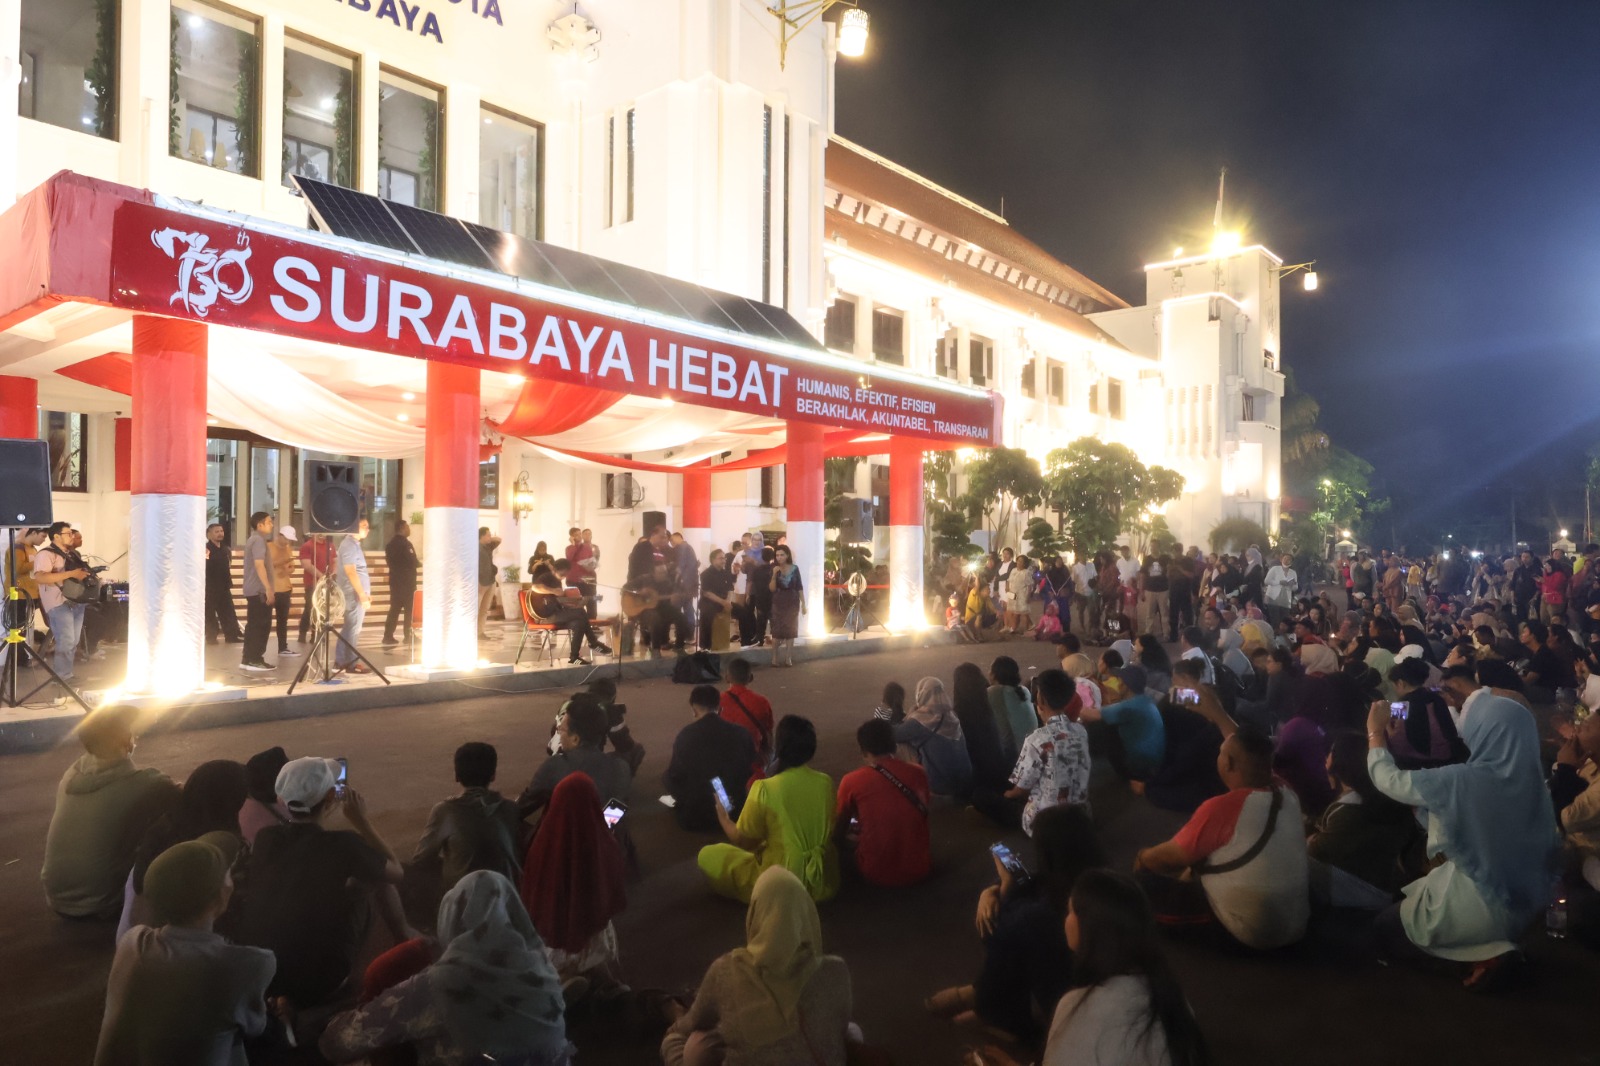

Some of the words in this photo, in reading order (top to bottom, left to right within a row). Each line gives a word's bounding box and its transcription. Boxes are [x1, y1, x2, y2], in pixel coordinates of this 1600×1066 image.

[270, 255, 634, 383] SURABAYA
[648, 338, 789, 408] HEBAT
[797, 378, 852, 403] HUMANIS,
[855, 388, 899, 410] EFEKTIF,
[901, 397, 936, 415] EFISIEN
[796, 398, 869, 424] BERAKHLAK,
[871, 411, 931, 433] AKUNTABEL,
[933, 420, 989, 439] TRANSPARAN
